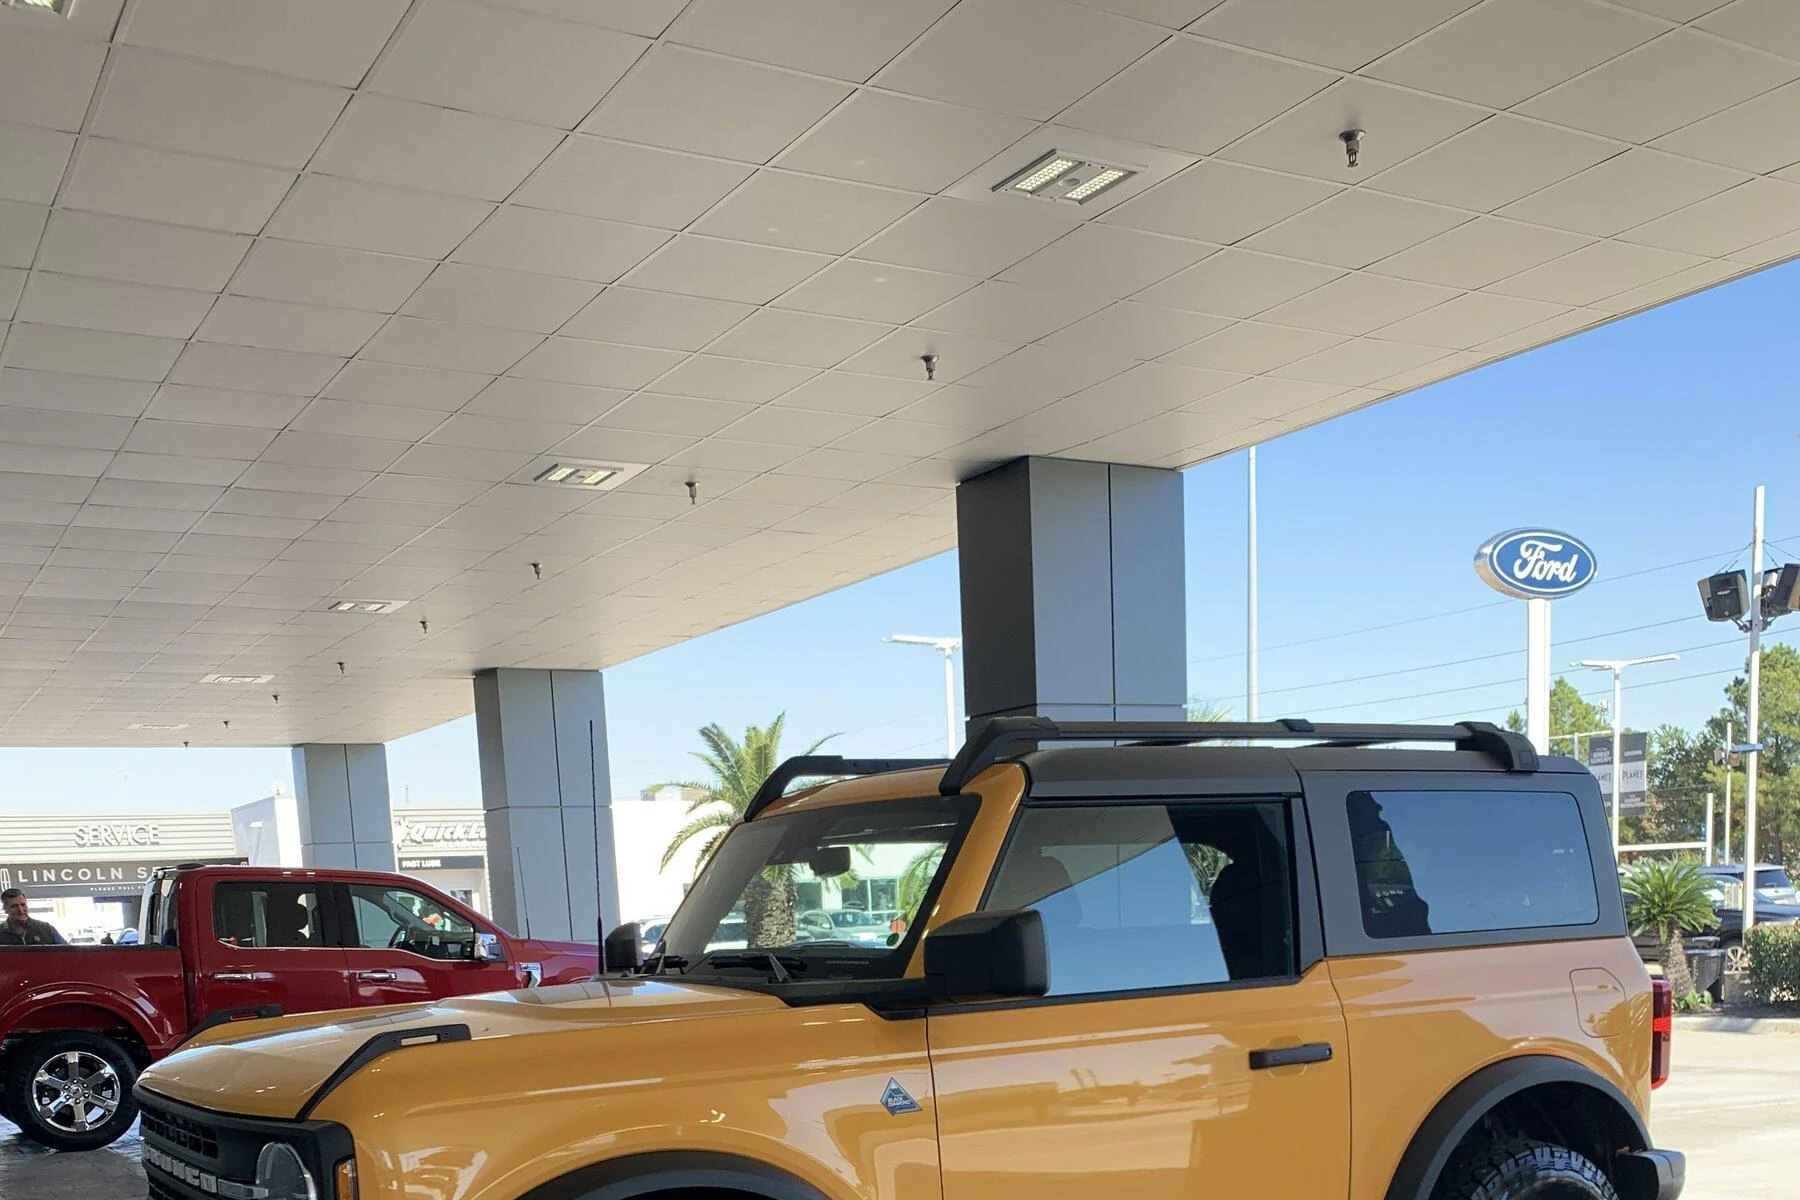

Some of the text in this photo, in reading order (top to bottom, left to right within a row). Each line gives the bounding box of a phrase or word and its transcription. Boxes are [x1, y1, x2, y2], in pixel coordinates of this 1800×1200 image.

[1513, 539, 1579, 583] Ford
[73, 823, 160, 848] SERVICE
[18, 867, 123, 883] LINCOLN
